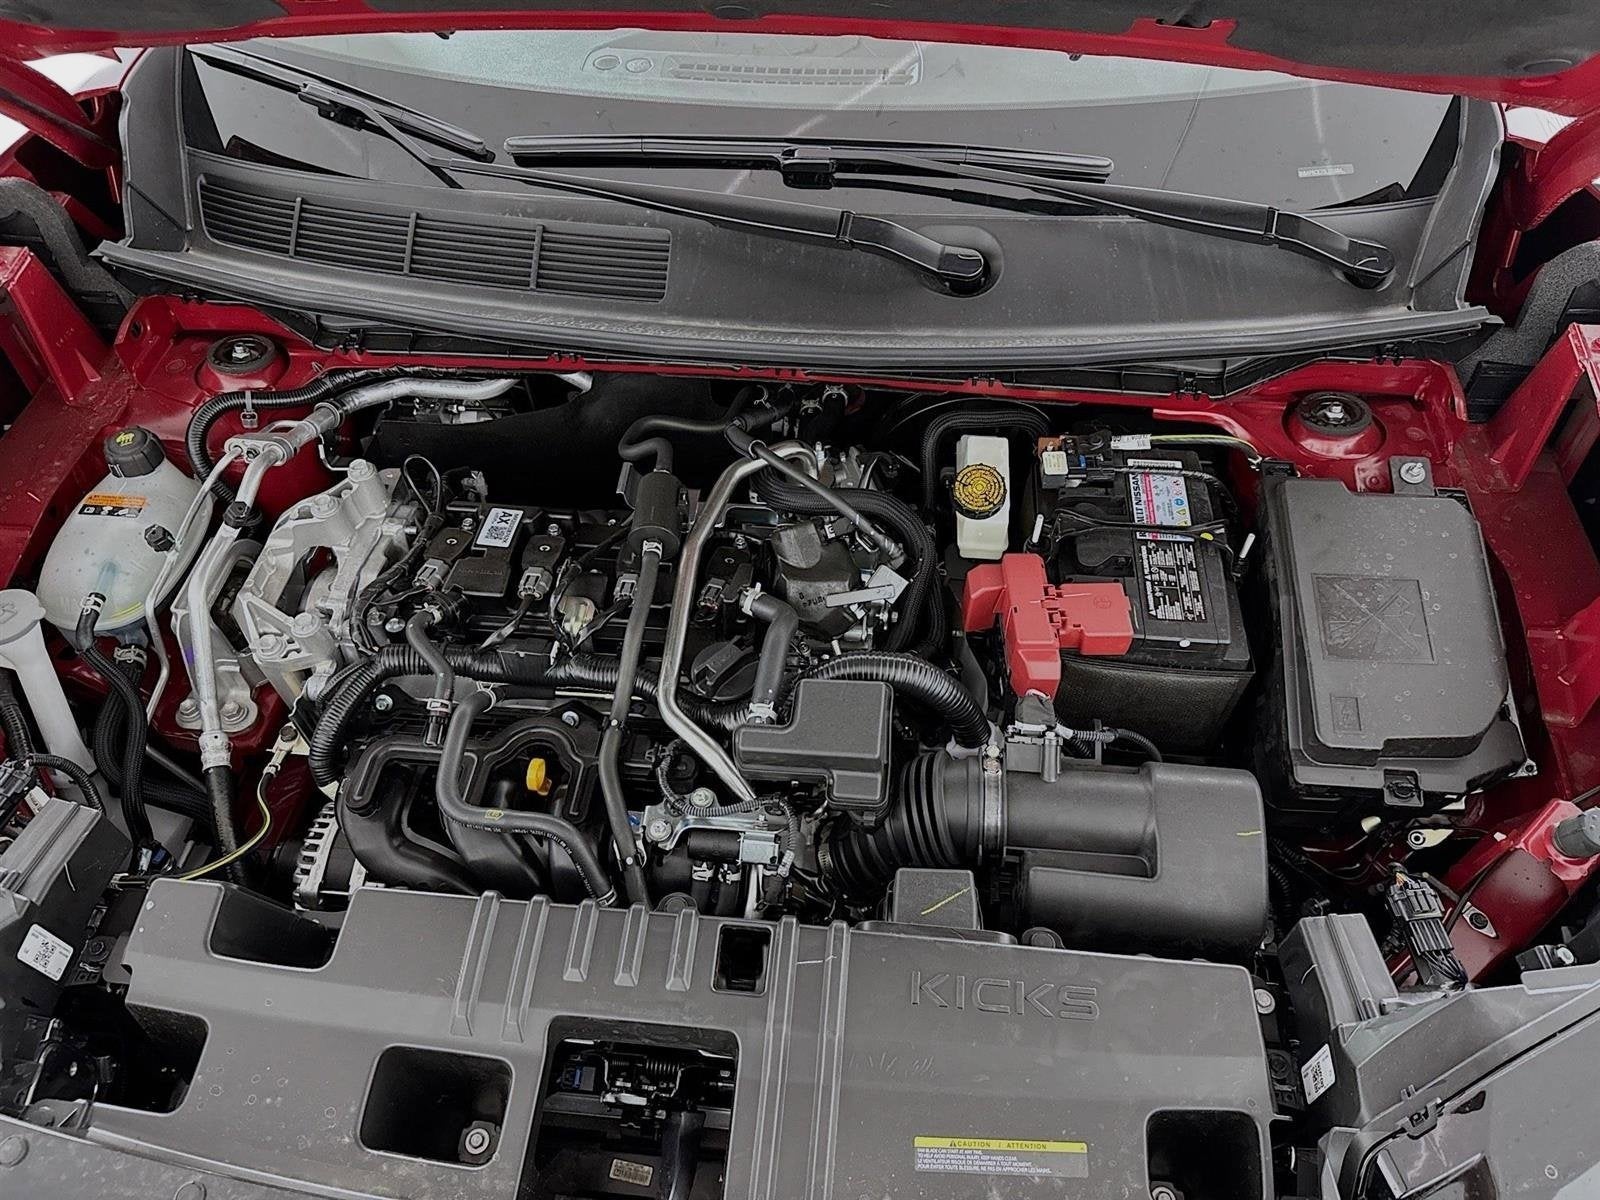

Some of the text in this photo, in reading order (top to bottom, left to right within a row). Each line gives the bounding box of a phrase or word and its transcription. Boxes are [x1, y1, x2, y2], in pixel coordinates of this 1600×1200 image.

[1131, 472, 1143, 506] NISSAN
[497, 511, 512, 525] AX
[911, 971, 1100, 1021] KICKS
[957, 1140, 991, 1148] CAUTION
[1006, 1142, 1047, 1150] ATTENTION
